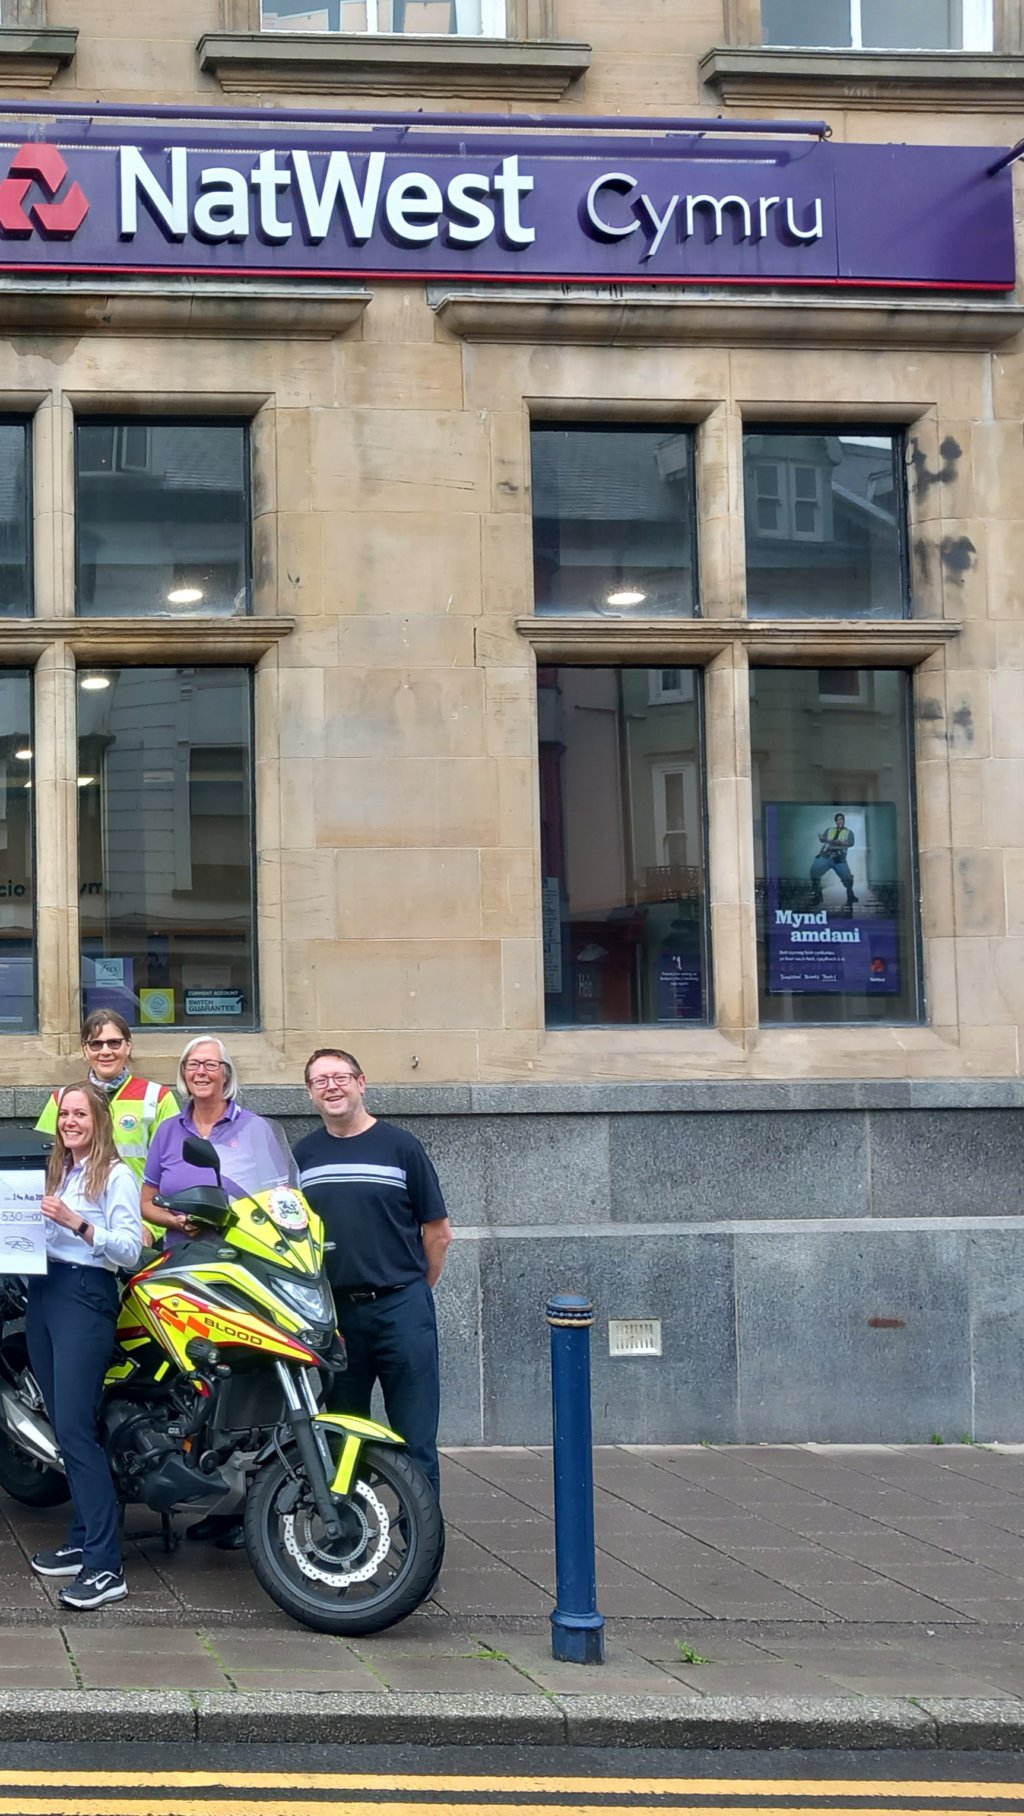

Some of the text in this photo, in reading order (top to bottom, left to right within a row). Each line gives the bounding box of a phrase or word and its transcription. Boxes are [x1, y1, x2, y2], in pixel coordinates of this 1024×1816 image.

[120, 145, 824, 262] NatWest Cymru
[775, 909, 828, 928] Mynd
[790, 928, 861, 943] amdani
[204, 1317, 263, 1346] BLOOD
